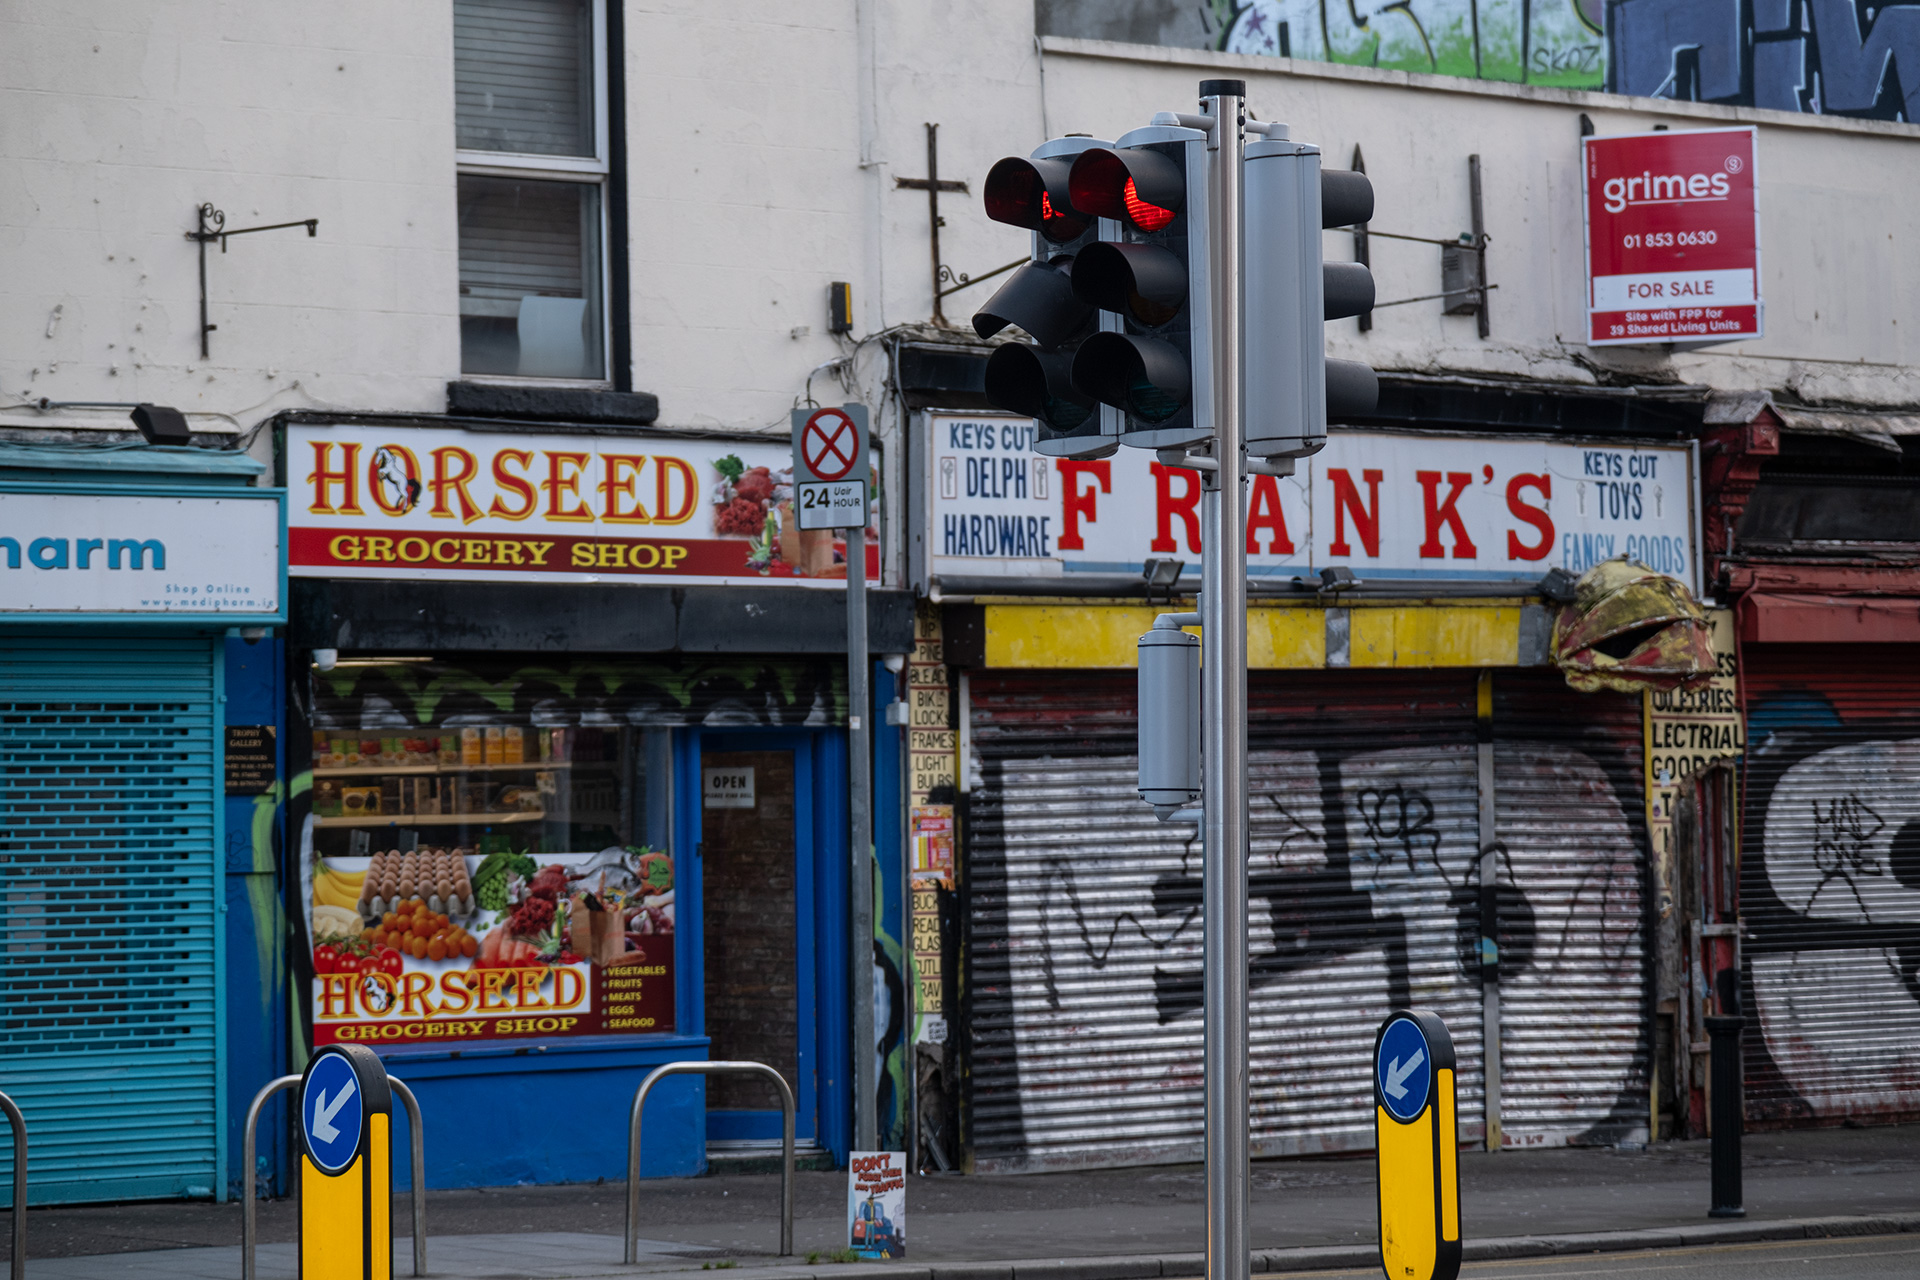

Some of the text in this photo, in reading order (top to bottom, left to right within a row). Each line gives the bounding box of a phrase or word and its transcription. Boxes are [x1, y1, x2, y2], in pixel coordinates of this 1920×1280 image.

[1603, 171, 1730, 213] grimes
[1623, 230, 1718, 249] 01 853 0630
[1628, 280, 1714, 299] FOR SALE
[1625, 307, 1722, 322] Site with FPP for
[1610, 319, 1740, 336] 39 Shared Living Units
[950, 423, 995, 450] KEYS
[1584, 451, 1657, 479] KEYS CUT
[306, 440, 699, 526] HORSEED
[967, 457, 1027, 499] DELPH
[803, 487, 852, 509] 24 Uair
[834, 498, 860, 508] HOUR
[1596, 480, 1643, 520] TOYS
[945, 514, 1050, 557] HARDWARE
[329, 534, 688, 569] GROCERY SHOP
[166, 584, 250, 595] Shop Online
[920, 622, 935, 638] UP
[233, 729, 260, 737] TROPHY
[912, 732, 955, 748] FRAMES
[229, 739, 262, 747] GALLERY
[916, 756, 947, 771] LIGHT
[713, 776, 746, 788] OPEN
[607, 965, 667, 977] VEGETABLES
[608, 979, 643, 989] FRUITS
[315, 966, 586, 1021] HORSEED
[608, 992, 642, 1002] MEATS
[608, 1005, 635, 1016] EGGS
[334, 1016, 579, 1041] GROCERY SHOP
[608, 1018, 656, 1029] SEAFOOD
